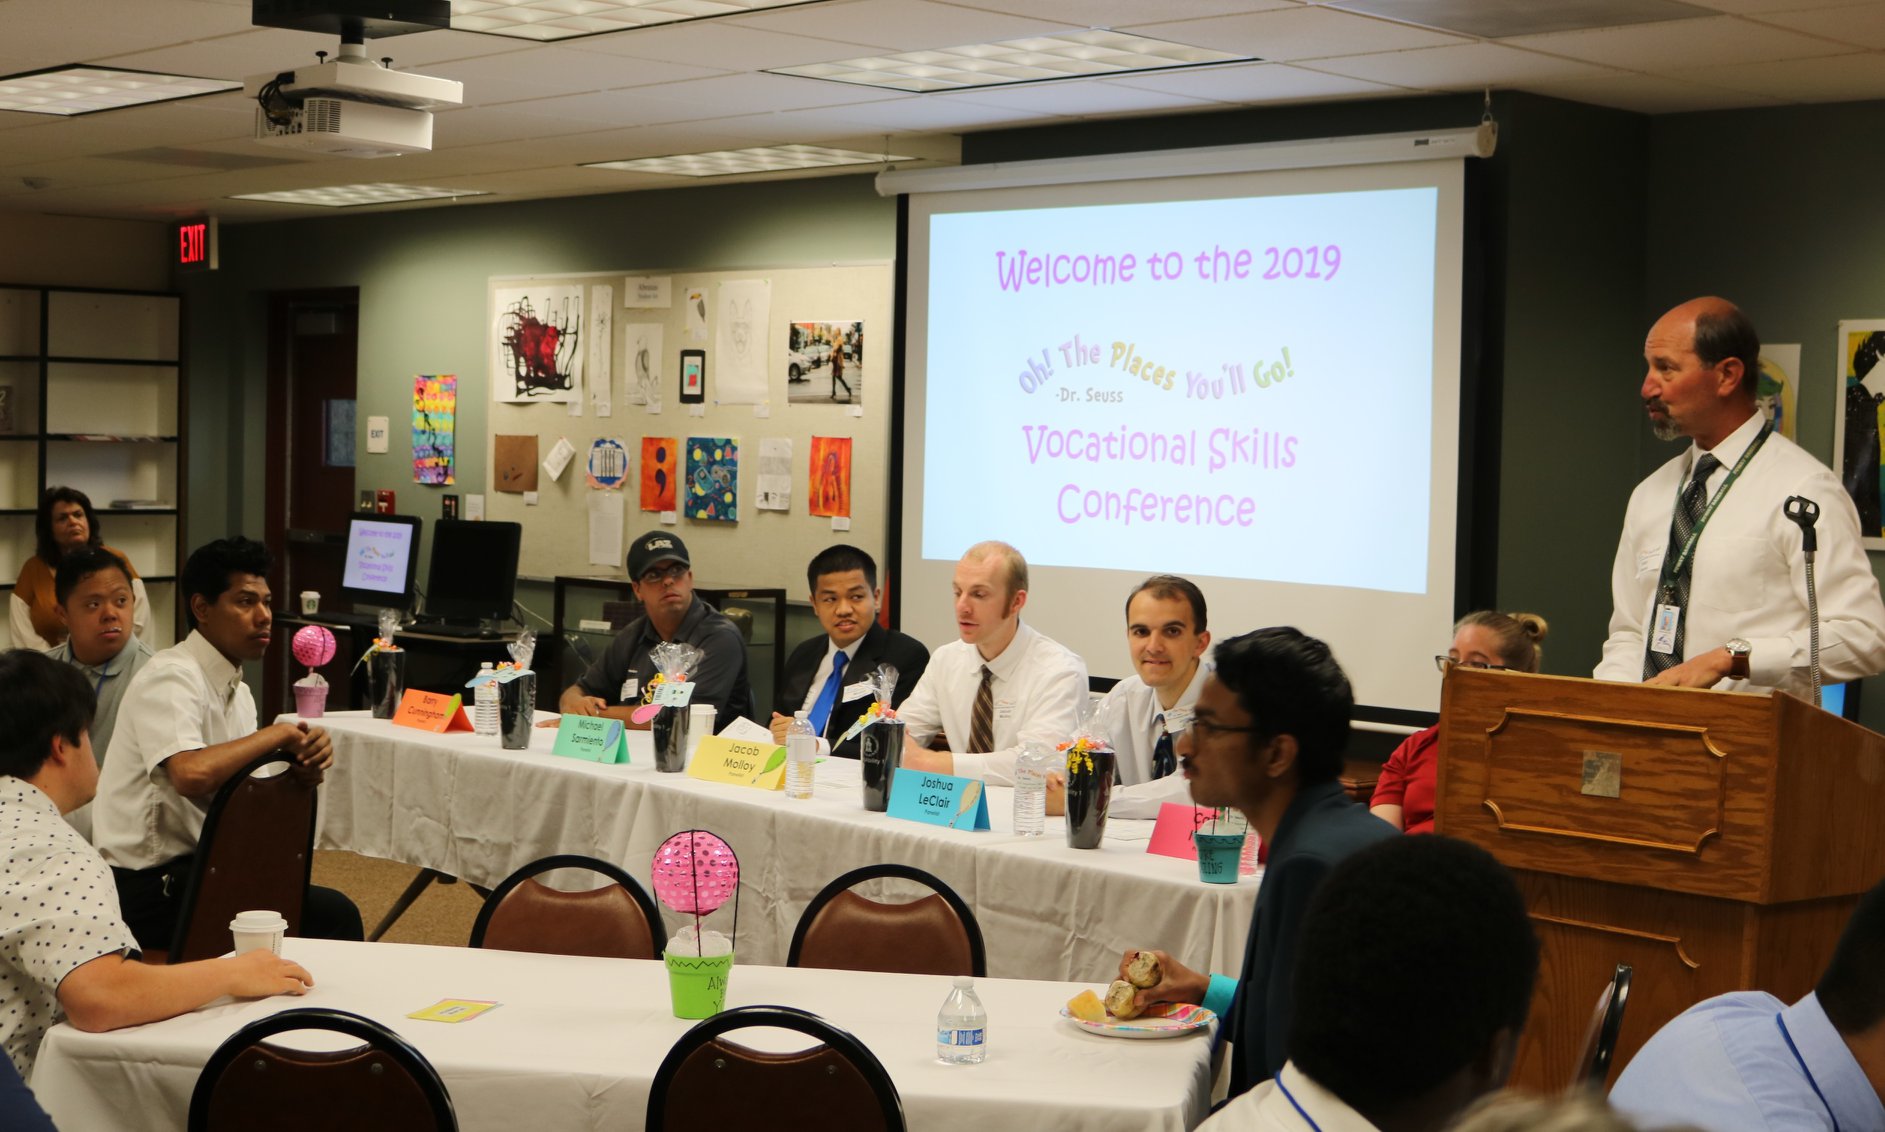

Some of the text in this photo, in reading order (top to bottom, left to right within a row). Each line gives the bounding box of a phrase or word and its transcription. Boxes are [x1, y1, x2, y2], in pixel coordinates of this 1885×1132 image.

[180, 224, 205, 263] EXIT
[996, 244, 1342, 292] Welcome to the 2019
[1018, 333, 1296, 400] Oh! The Places You'll Go!
[1055, 386, 1125, 403] -Dr. Seuss
[371, 429, 384, 439] EXIT
[1022, 424, 1299, 475] Vocational Skills
[1057, 483, 1257, 528] Conference
[578, 719, 604, 732] Michael
[571, 733, 604, 747] Sarmiento
[728, 743, 760, 757] Jacob
[722, 757, 756, 774] Molloy
[921, 776, 954, 792] Joshua
[918, 793, 951, 810] LeClair
